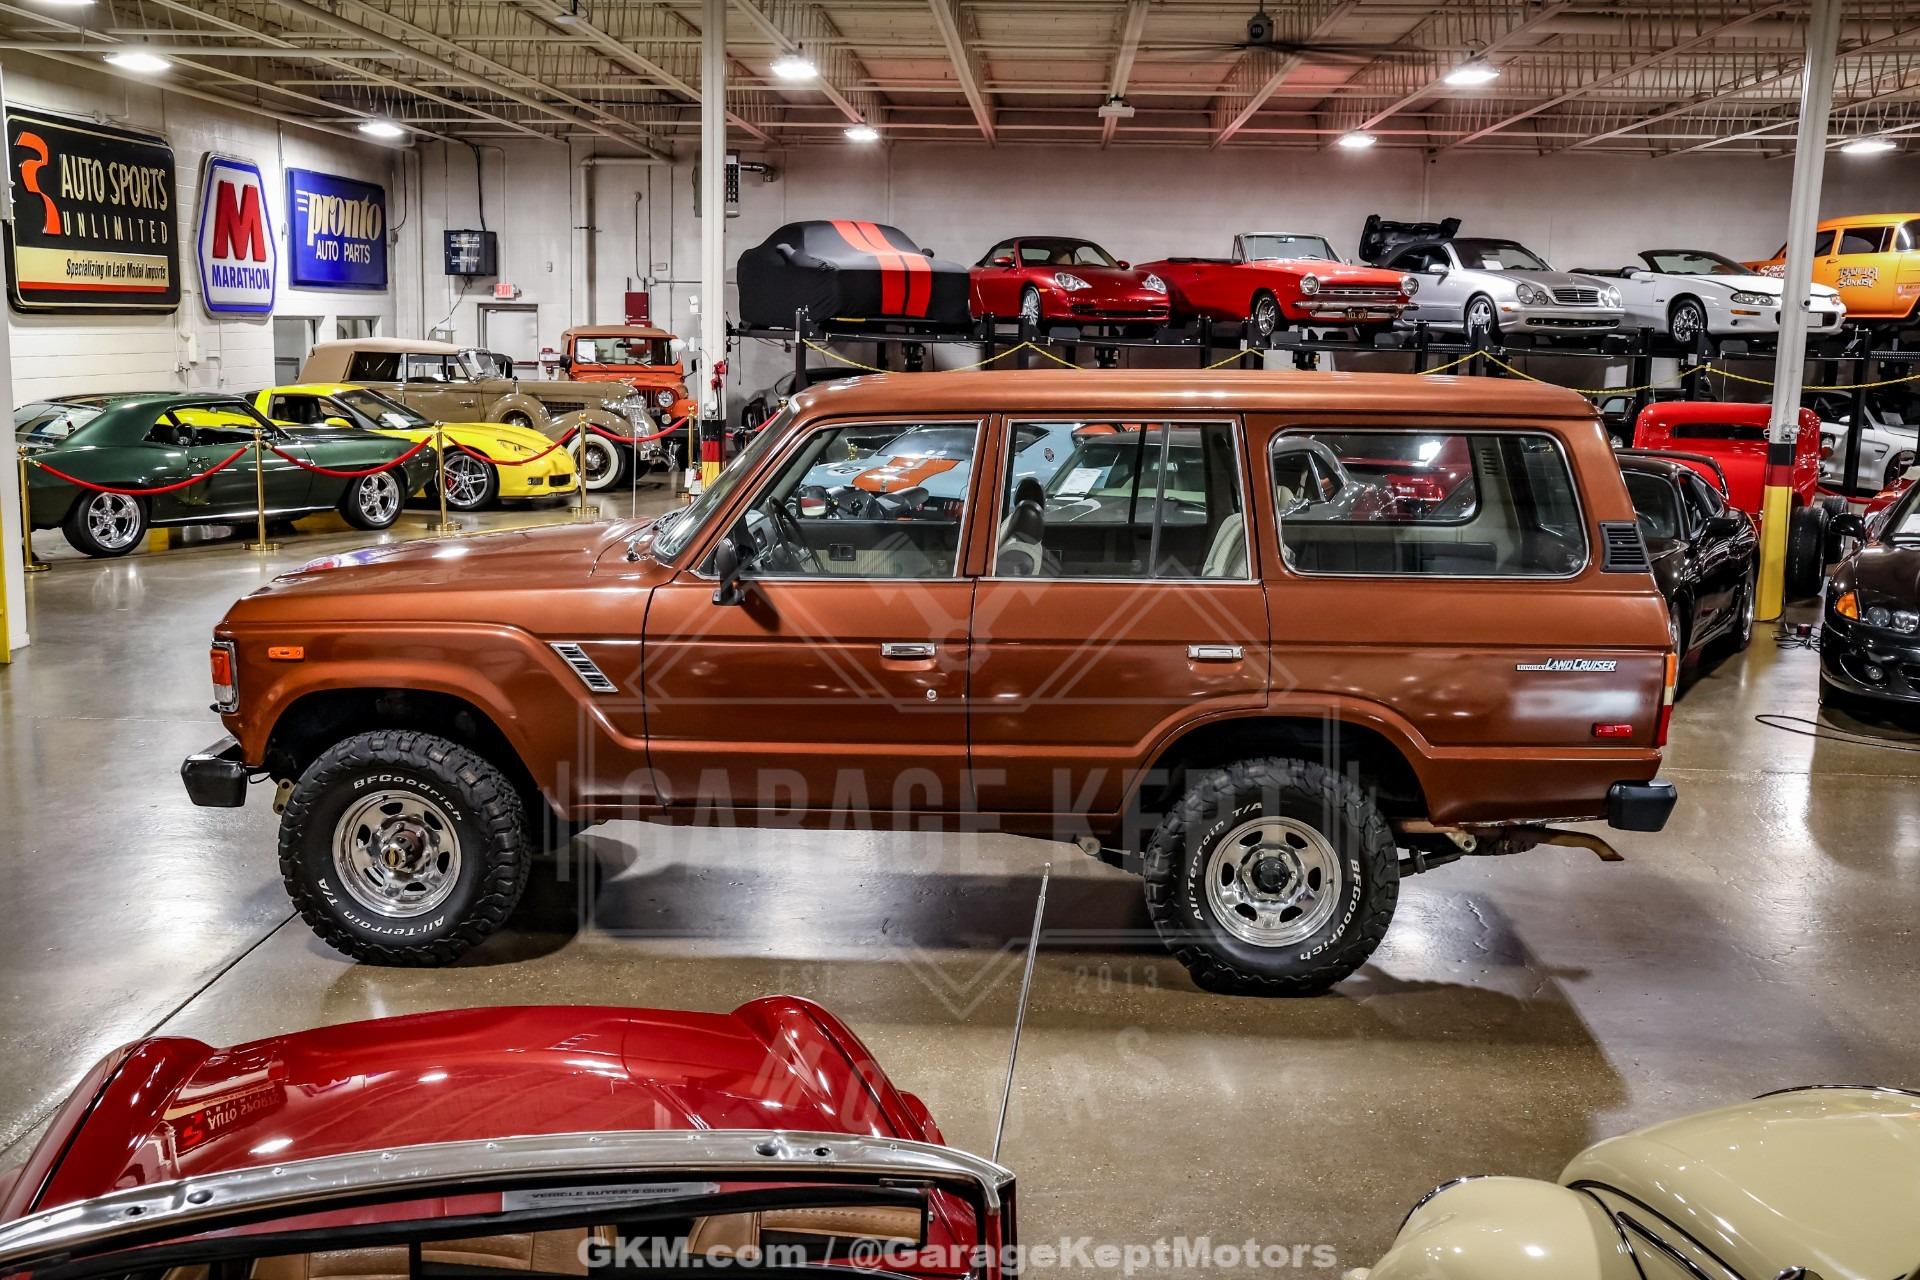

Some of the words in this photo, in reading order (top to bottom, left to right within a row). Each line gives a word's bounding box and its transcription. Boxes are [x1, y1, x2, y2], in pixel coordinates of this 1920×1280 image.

[59, 154, 105, 203] AUTO
[109, 161, 168, 211] SPORTS
[62, 211, 168, 245] UNLIMITED
[306, 193, 383, 246] pronto
[315, 241, 339, 261] AUTO
[344, 243, 371, 264] PARTS
[66, 258, 104, 280] Specializing
[112, 261, 125, 278] Late
[127, 262, 144, 278] Model
[145, 263, 166, 280] Imports
[212, 264, 270, 289] MARATHON
[496, 286, 512, 297] EXIT
[353, 774, 463, 821] BFGoodrich
[1186, 819, 1226, 922] All-Terrain
[1232, 801, 1263, 817] T/A
[316, 877, 340, 908] T/A
[342, 910, 446, 938] All-Terrain
[1299, 858, 1362, 961] BFGoodrich
